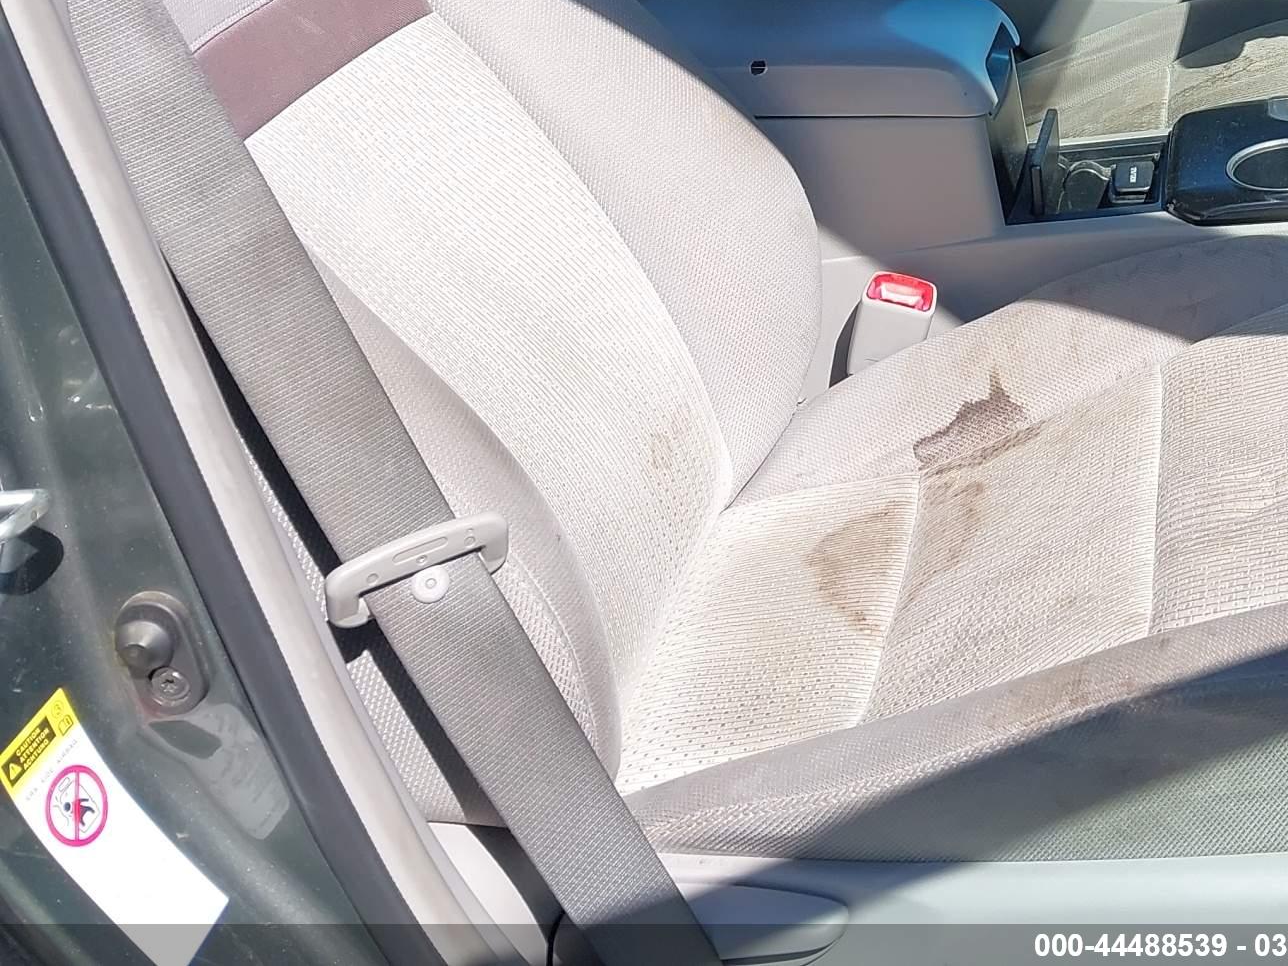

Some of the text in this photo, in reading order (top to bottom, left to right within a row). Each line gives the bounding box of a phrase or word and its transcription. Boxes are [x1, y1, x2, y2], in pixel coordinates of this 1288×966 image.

[15, 727, 42, 757] CAUTION
[19, 727, 50, 764] ATTENTION
[22, 739, 49, 771] ACHTUNG
